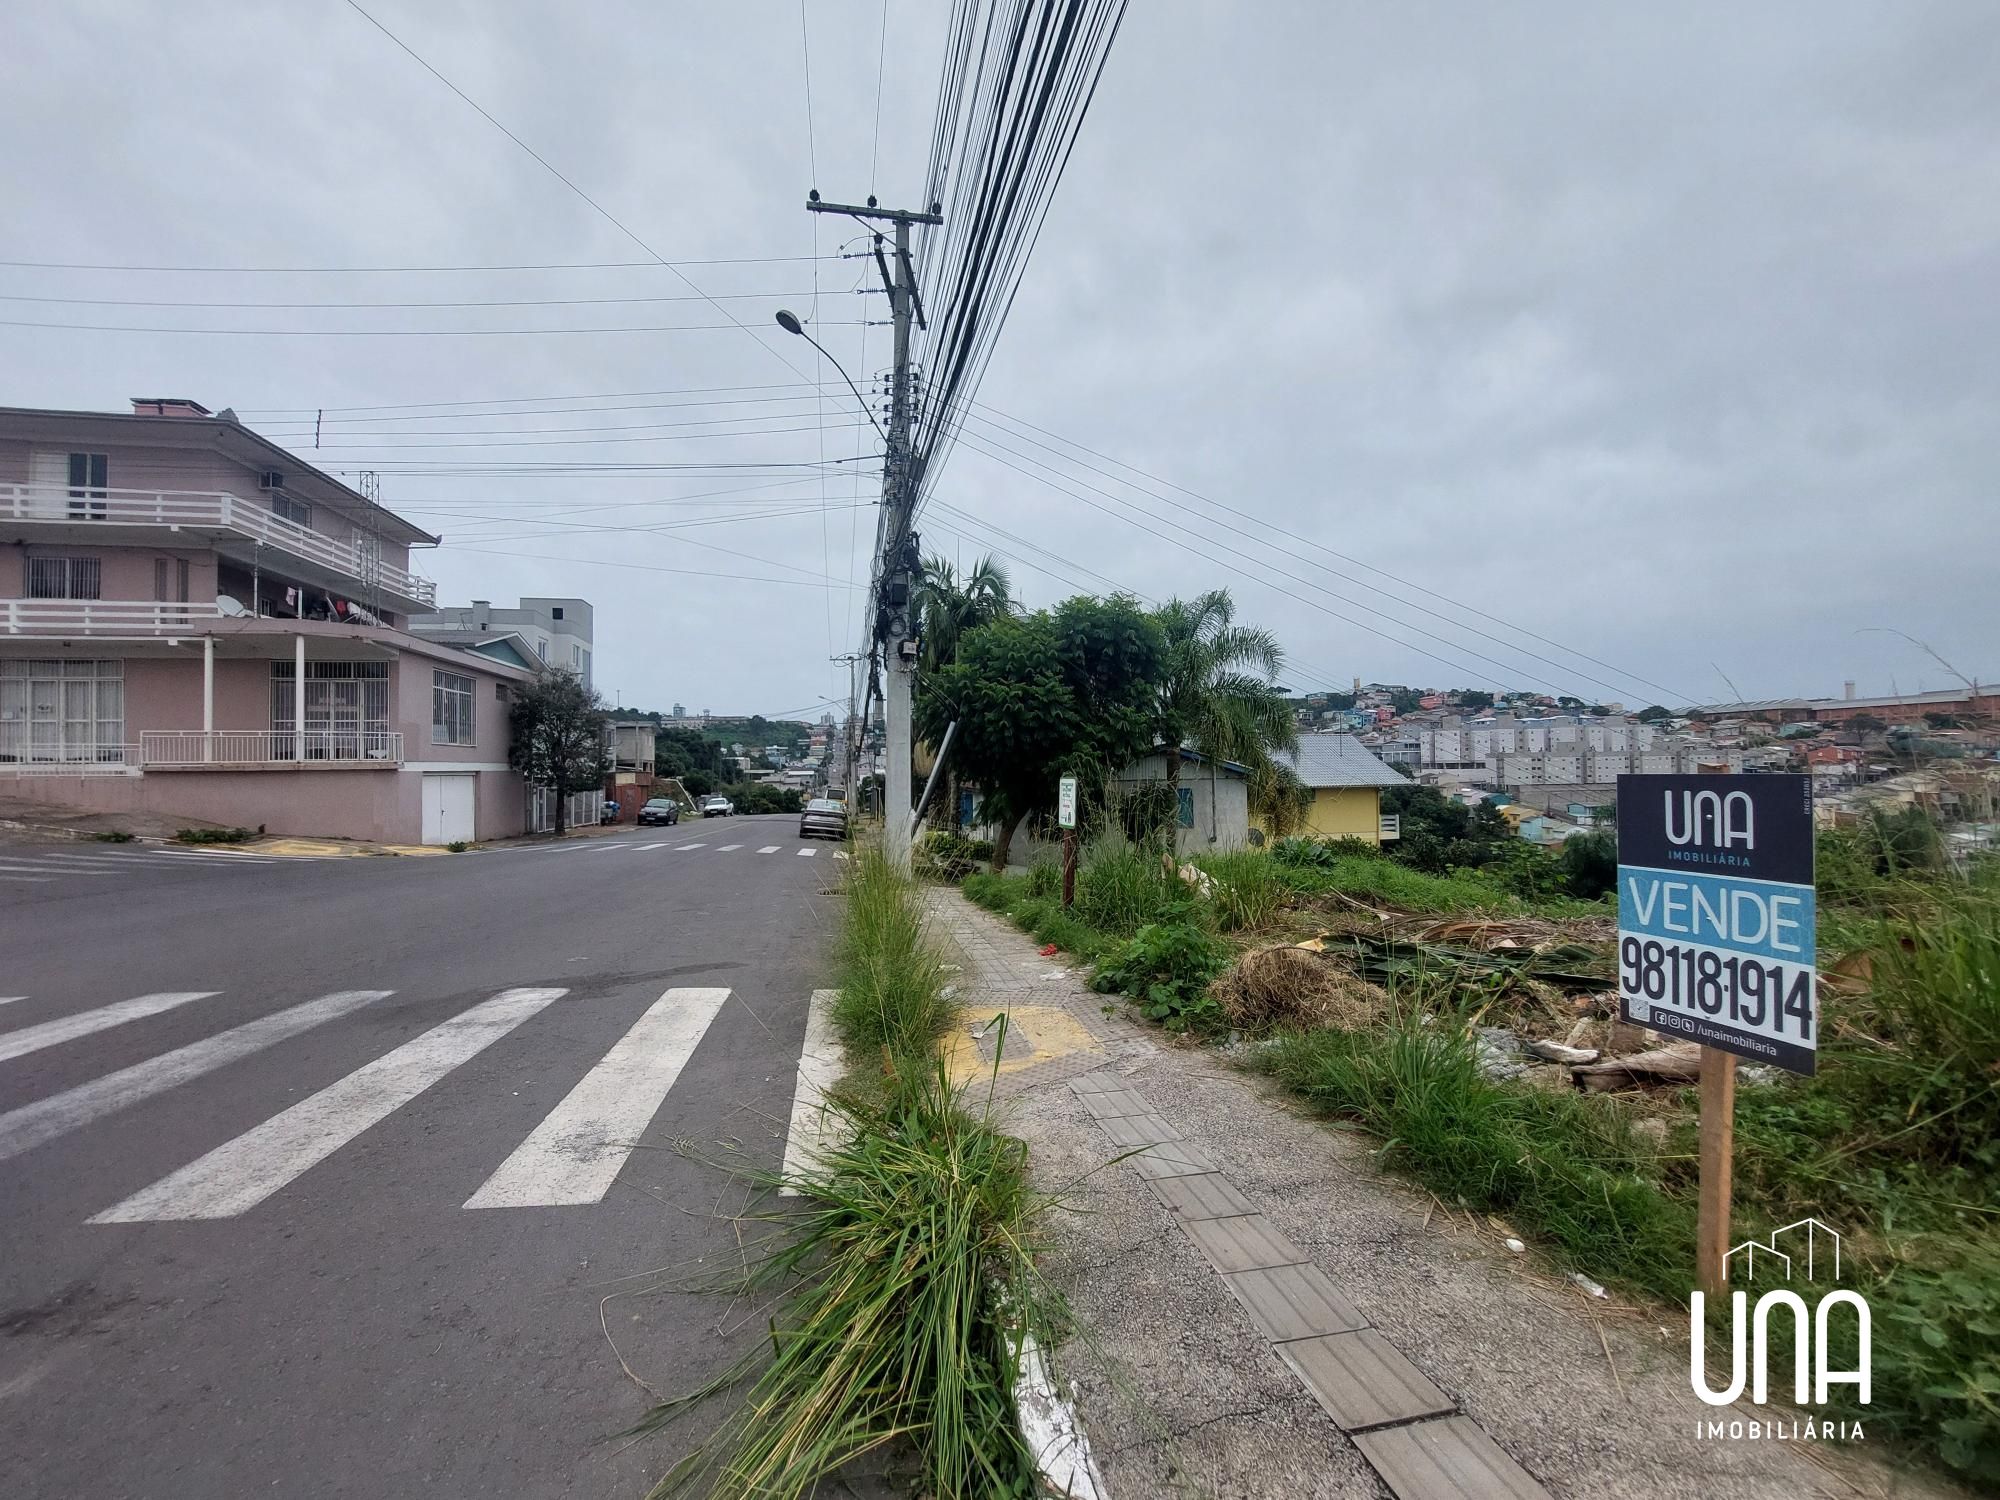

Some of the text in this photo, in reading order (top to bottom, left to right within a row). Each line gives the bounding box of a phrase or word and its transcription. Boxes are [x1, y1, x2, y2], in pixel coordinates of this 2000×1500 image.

[1664, 790, 1754, 850] UNA
[1668, 850, 1750, 867] IMOBILIÁRIA
[1628, 876, 1801, 953] VENDE
